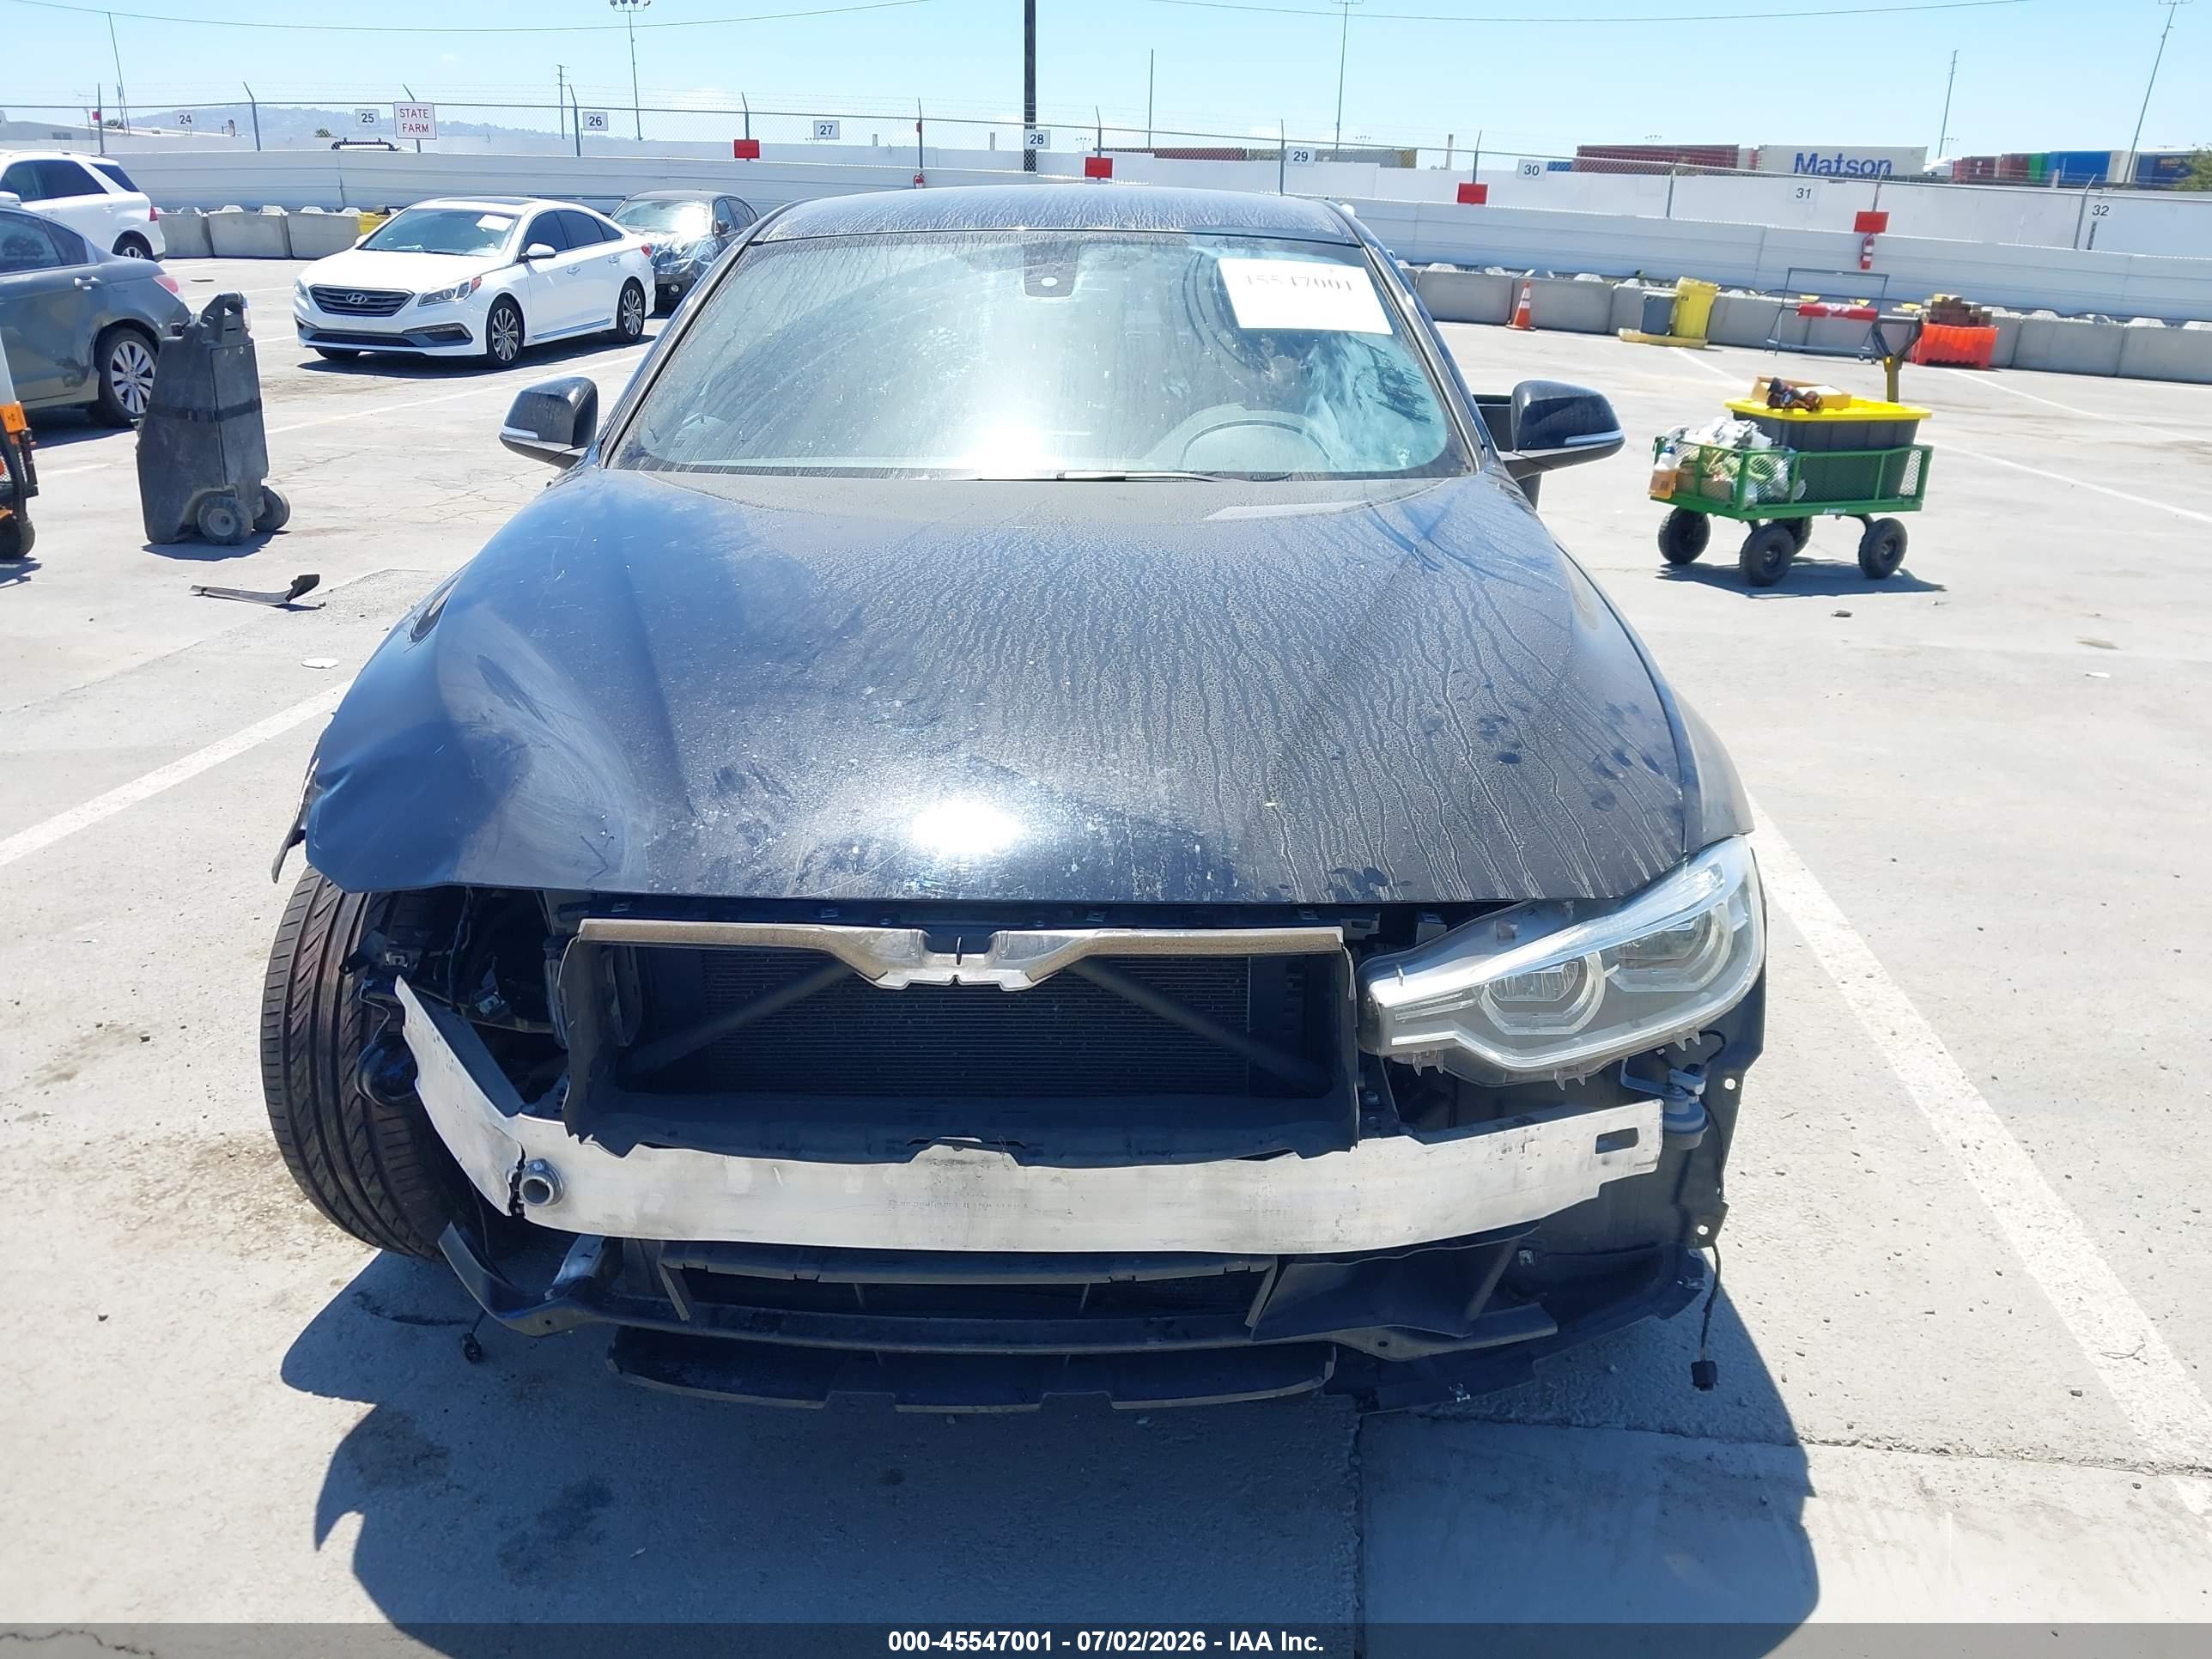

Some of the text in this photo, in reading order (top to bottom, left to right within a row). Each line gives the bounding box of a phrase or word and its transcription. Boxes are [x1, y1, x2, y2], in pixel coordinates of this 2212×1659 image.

[361, 112, 374, 124] 25
[399, 108, 429, 118] STATE
[179, 114, 192, 125] 24
[588, 116, 603, 127] 26
[402, 123, 429, 133] FARM
[819, 125, 834, 136] 27
[1030, 134, 1044, 145] 28
[1292, 150, 1309, 162] 29
[1794, 152, 1893, 175] Matson
[1523, 164, 1540, 176] 30
[1796, 187, 1812, 199] 31
[2092, 204, 2110, 216] 32
